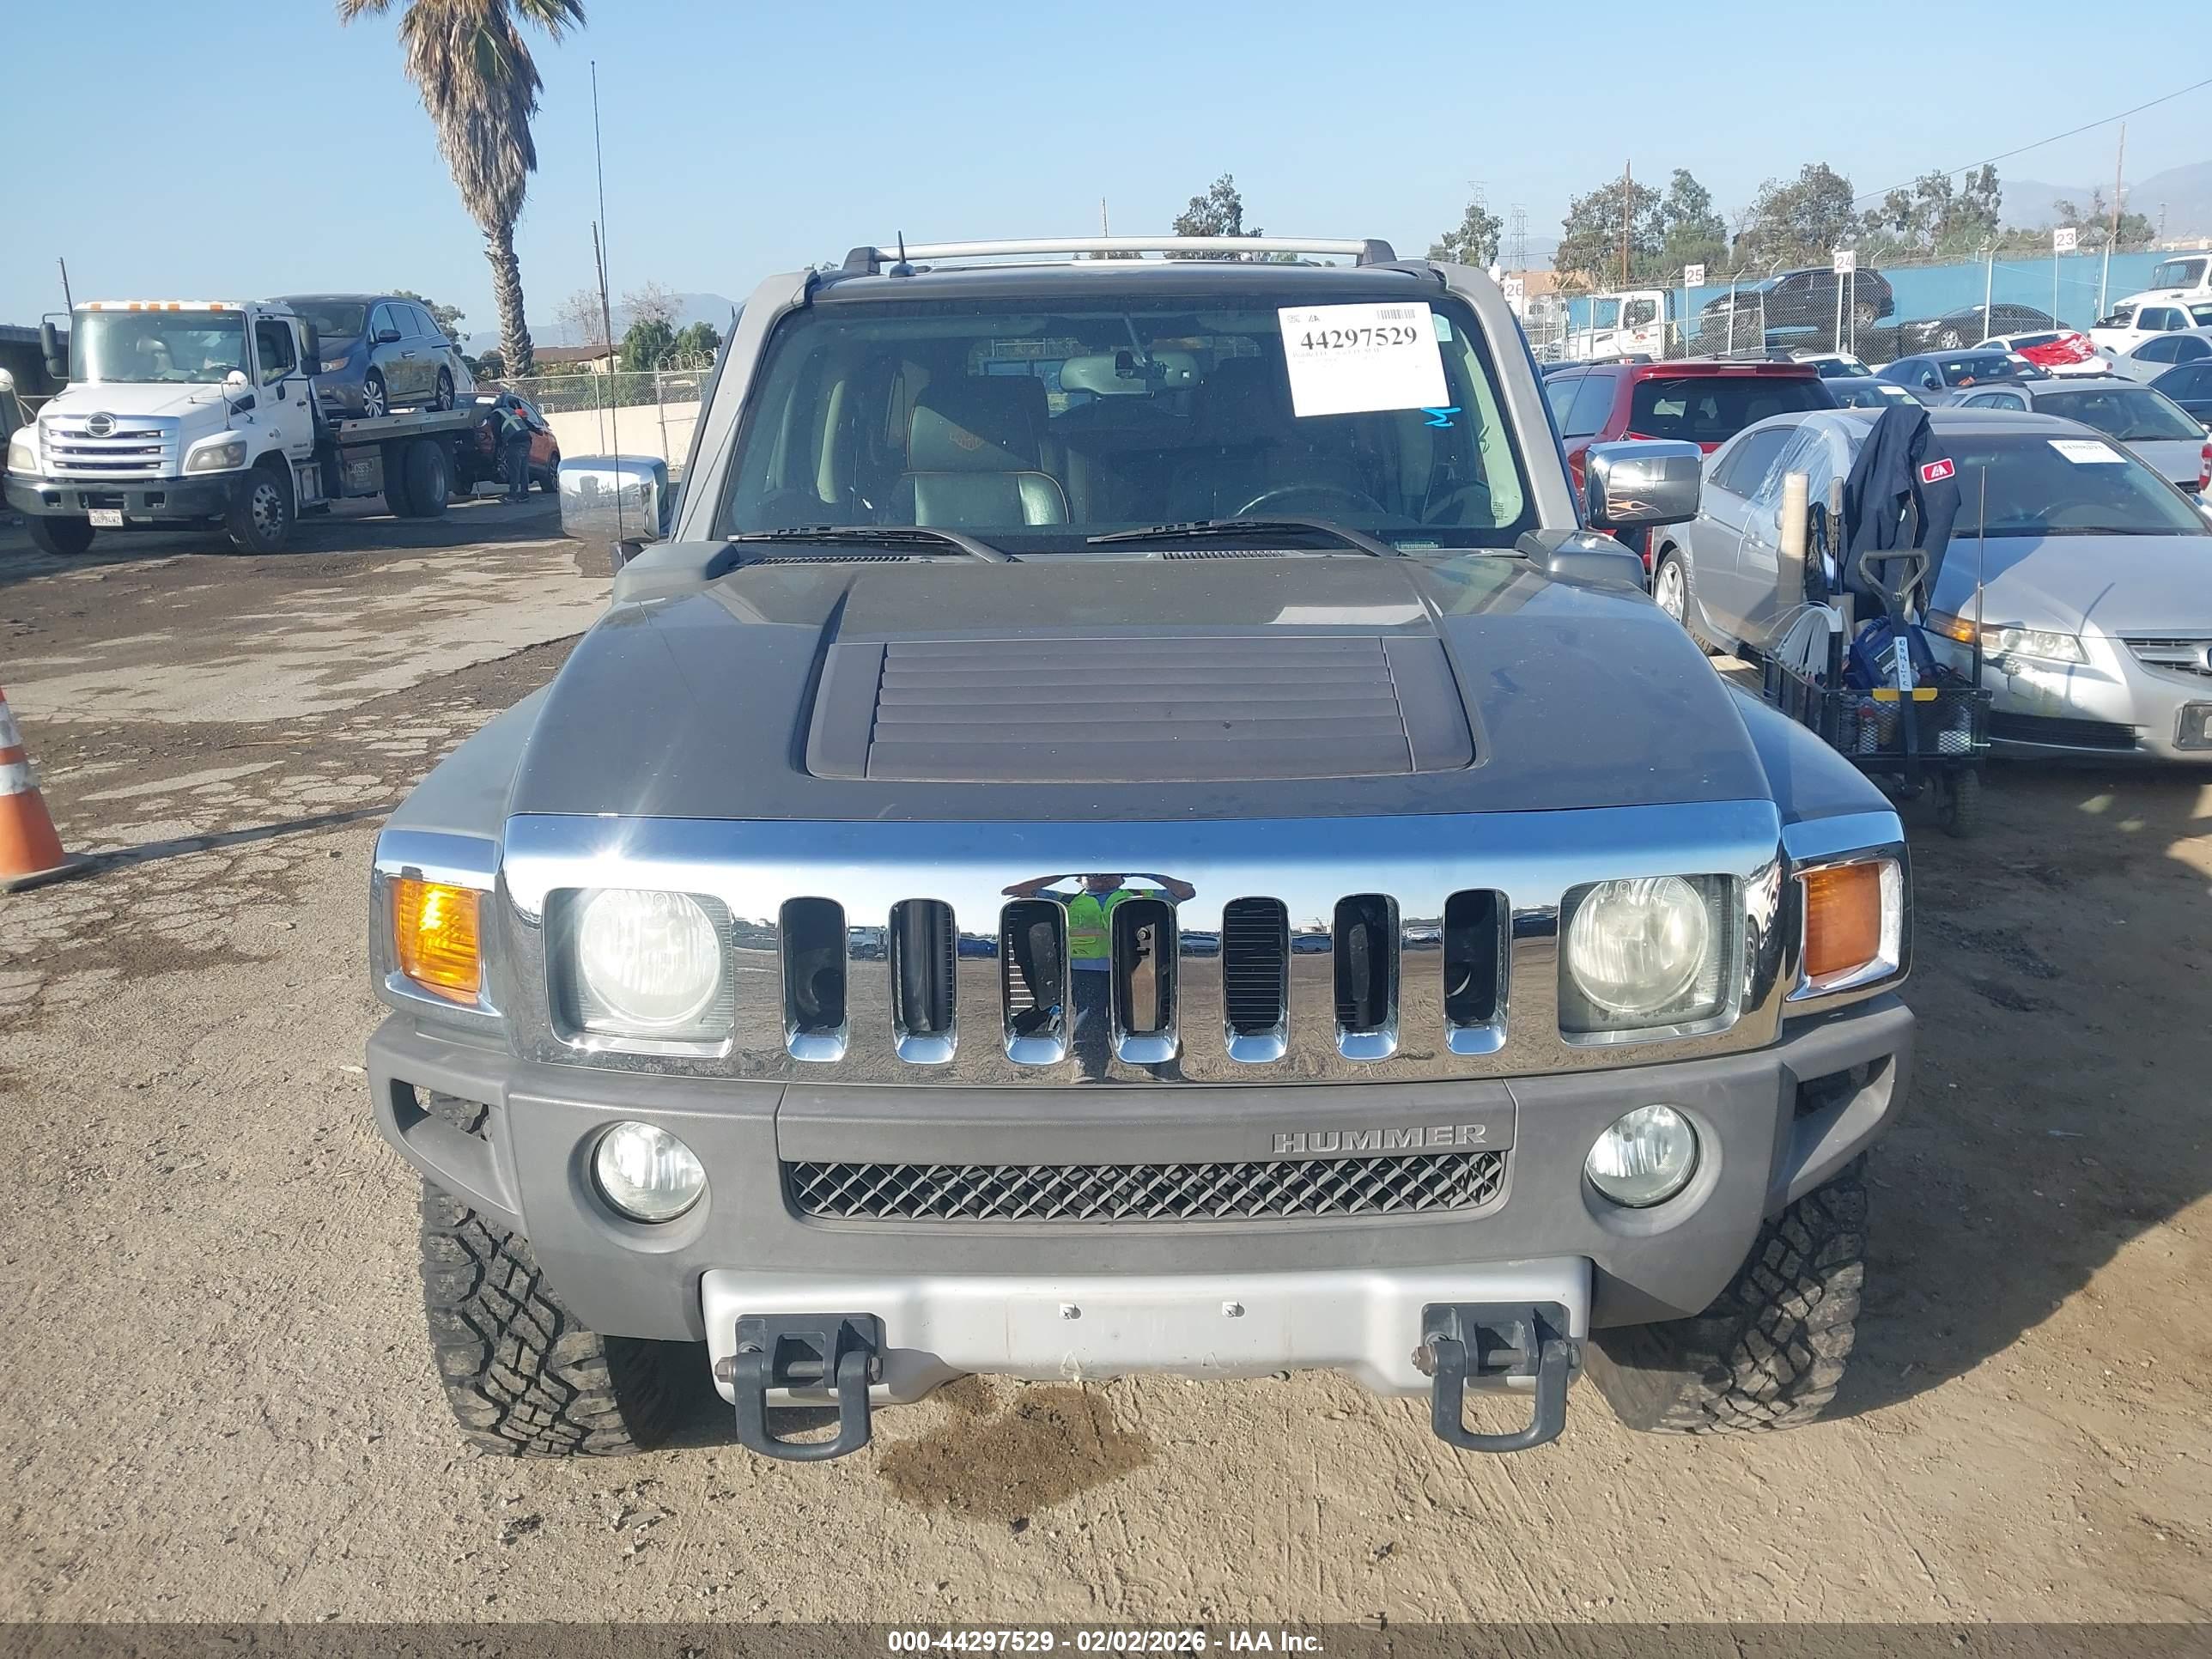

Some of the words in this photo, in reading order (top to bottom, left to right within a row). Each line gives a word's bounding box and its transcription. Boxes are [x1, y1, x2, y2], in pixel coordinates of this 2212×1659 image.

[2057, 234, 2075, 246] 23
[1836, 255, 1853, 269] 24
[1686, 270, 1703, 283] 25
[1300, 326, 1418, 350] 44297529
[1272, 1124, 1487, 1153] HUMMER
